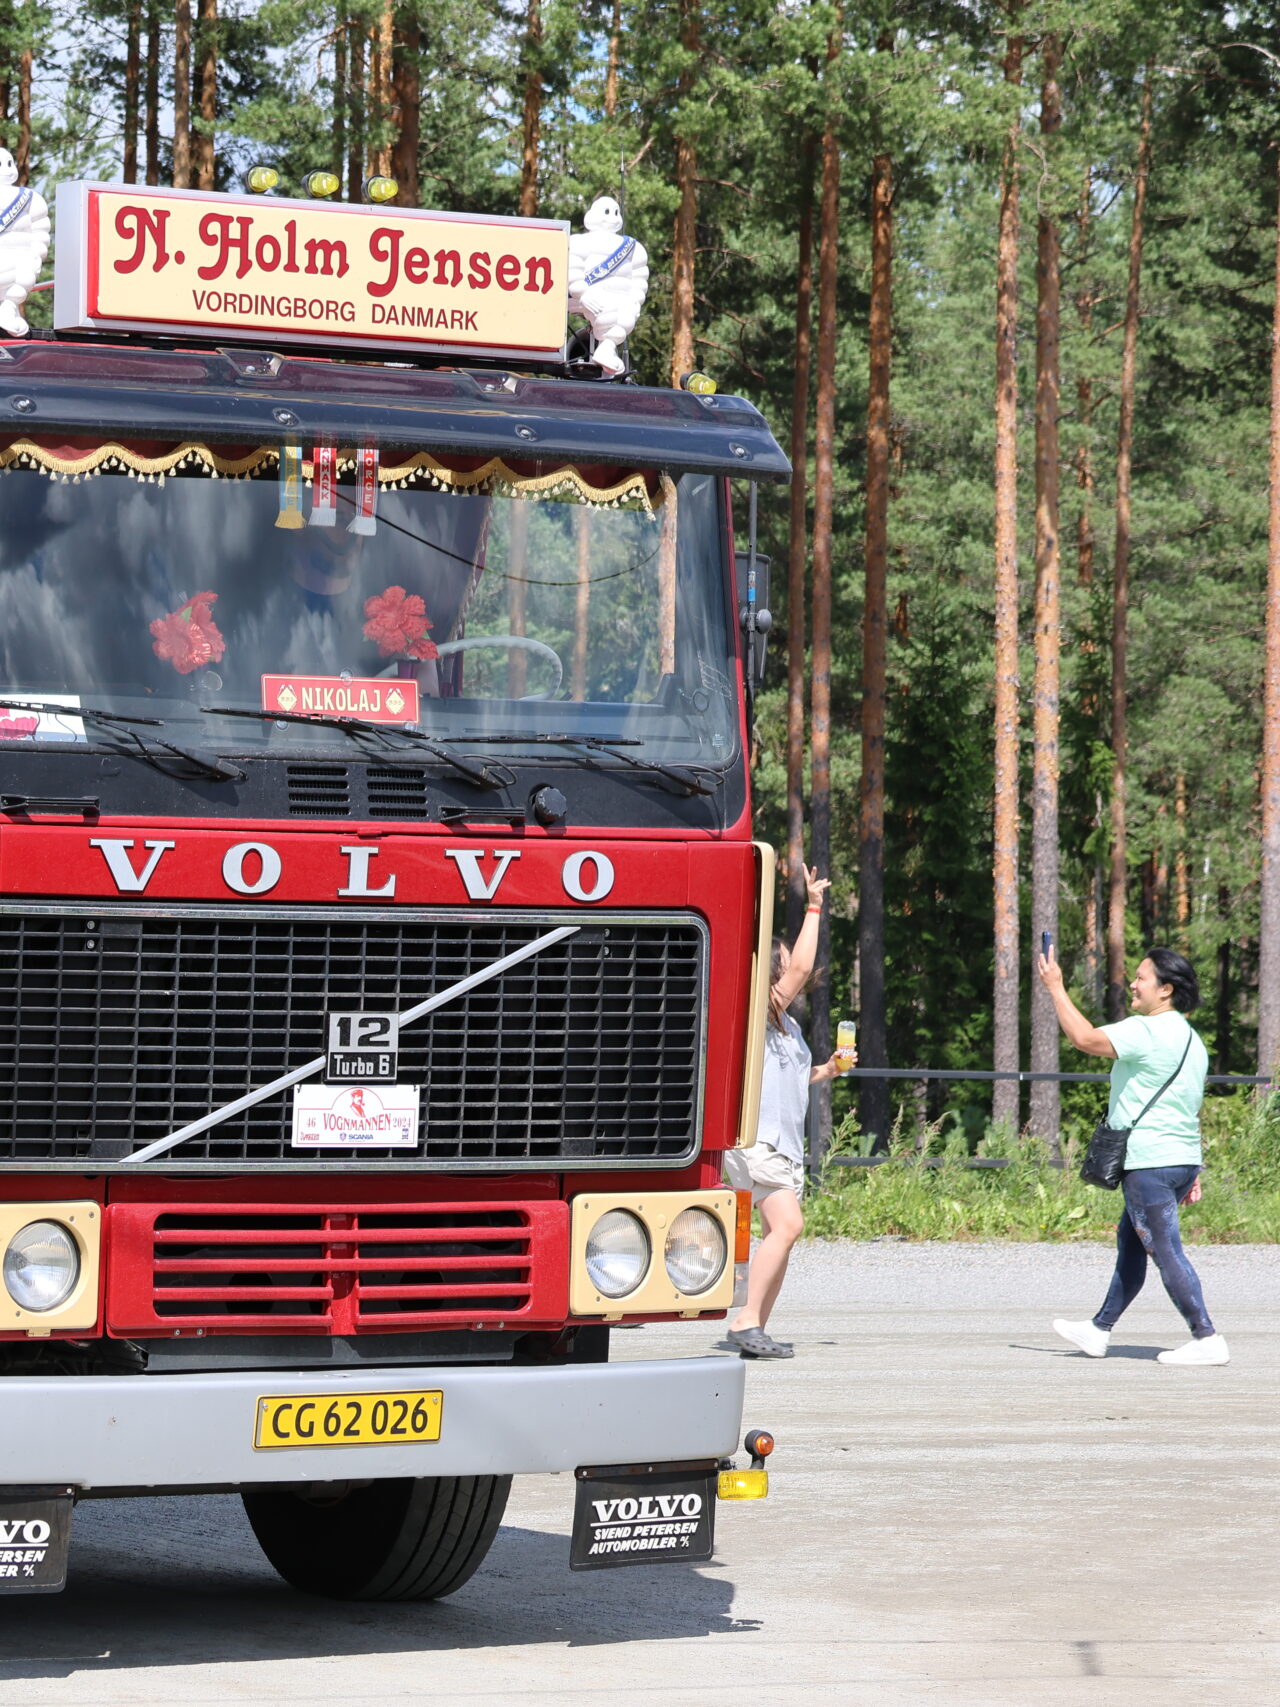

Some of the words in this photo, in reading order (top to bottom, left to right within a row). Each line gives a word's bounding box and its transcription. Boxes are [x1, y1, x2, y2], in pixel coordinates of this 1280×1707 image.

[114, 205, 185, 274] N.
[197, 212, 349, 281] Holm
[366, 227, 554, 298] Jensen
[192, 289, 356, 323] VORDINGBORG
[371, 303, 479, 332] DANMARK
[301, 687, 381, 712] NIKOLAJ
[90, 838, 615, 901] VOLVO
[336, 1017, 391, 1047] 12
[334, 1055, 374, 1075] Turbo
[379, 1055, 390, 1075] 6
[323, 1113, 391, 1131] VOGNMANNEN
[393, 1117, 411, 1129] 2024
[272, 1403, 316, 1438] CG
[323, 1401, 362, 1437] 62
[371, 1397, 428, 1435] 026
[592, 1493, 702, 1521] VOLVO
[594, 1526, 631, 1540] SVEND
[633, 1522, 699, 1537] PETERSEN
[588, 1537, 677, 1554] AUTOMOBILER
